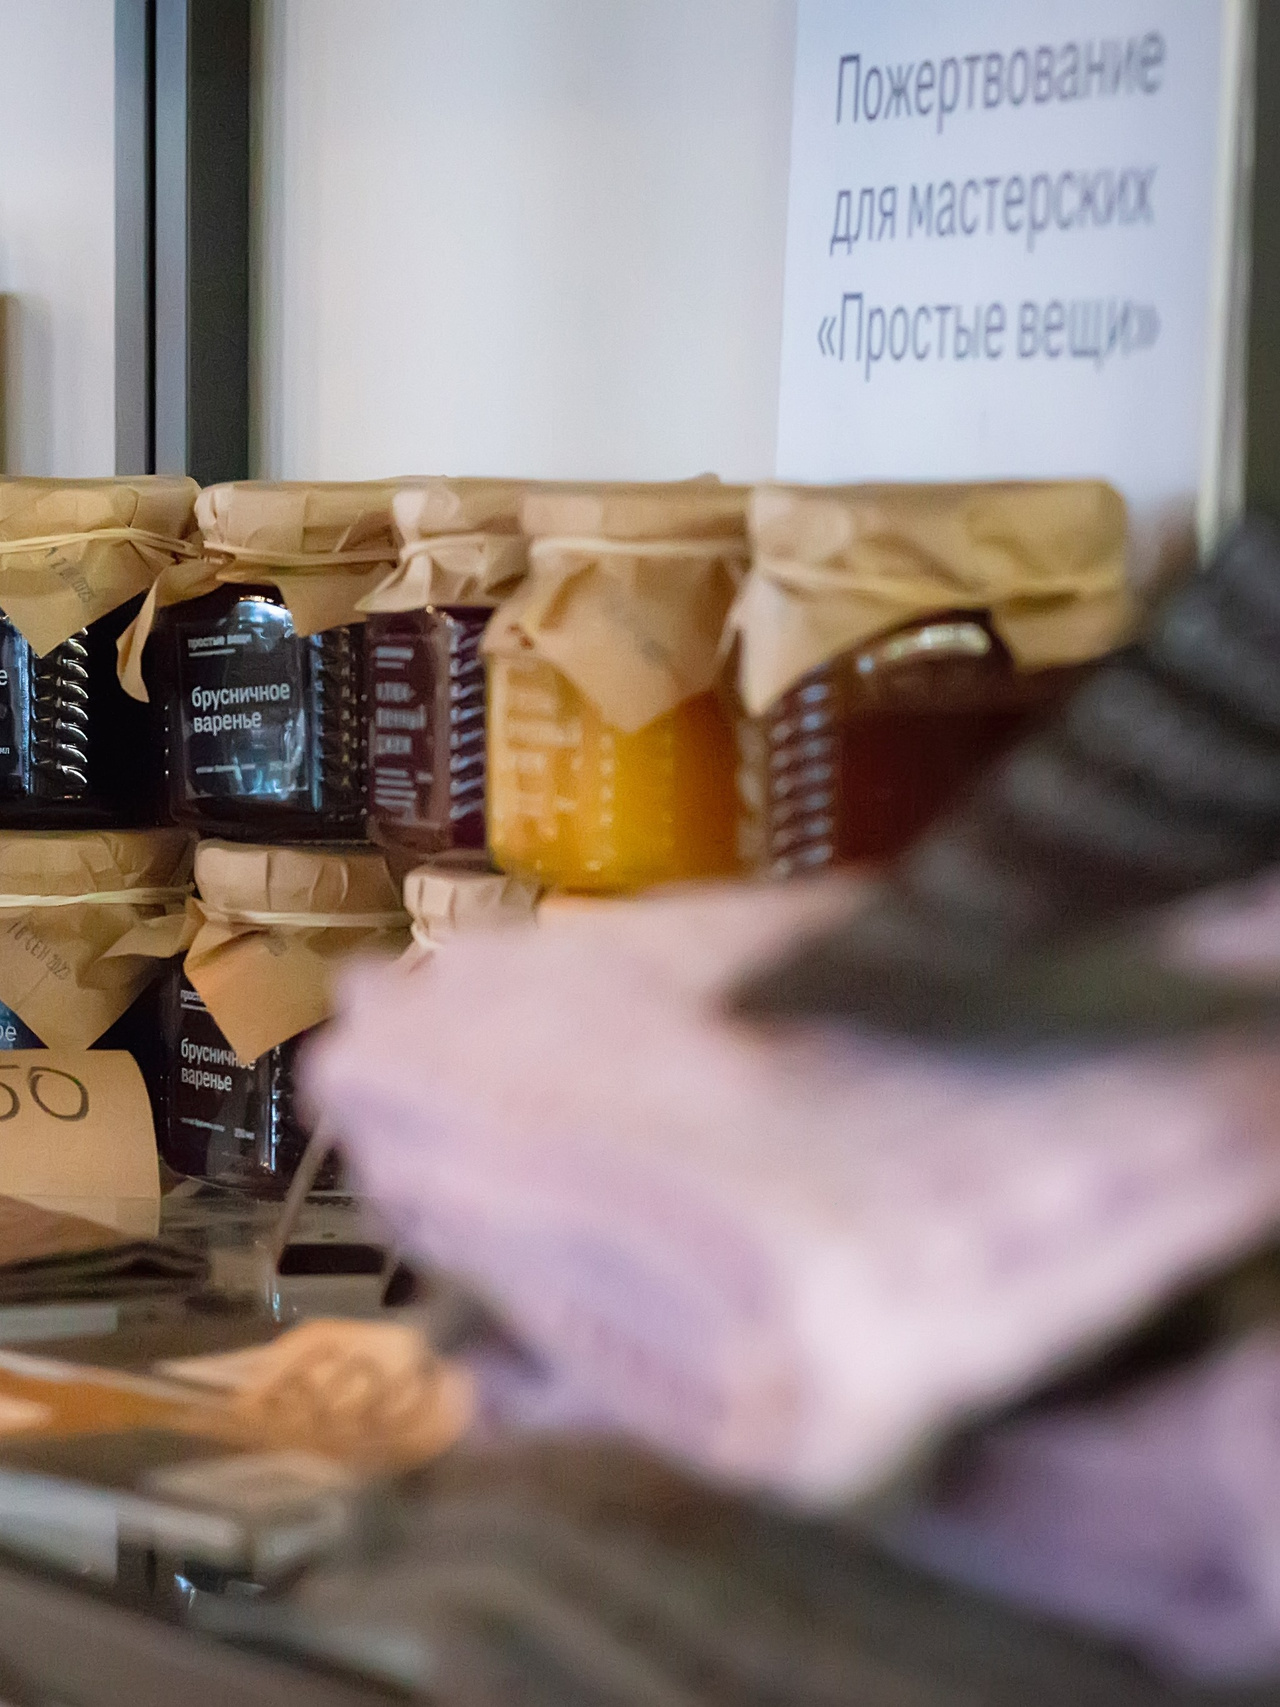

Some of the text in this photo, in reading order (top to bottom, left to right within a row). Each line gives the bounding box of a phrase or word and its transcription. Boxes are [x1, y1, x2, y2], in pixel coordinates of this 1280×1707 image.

[836, 30, 1168, 135] Пожертвование
[830, 165, 1159, 257] для мастерских
[817, 292, 1162, 383] «Простые вещи»
[191, 682, 291, 711] брусничное
[193, 711, 263, 737] варенье
[181, 1067, 232, 1091] варенье
